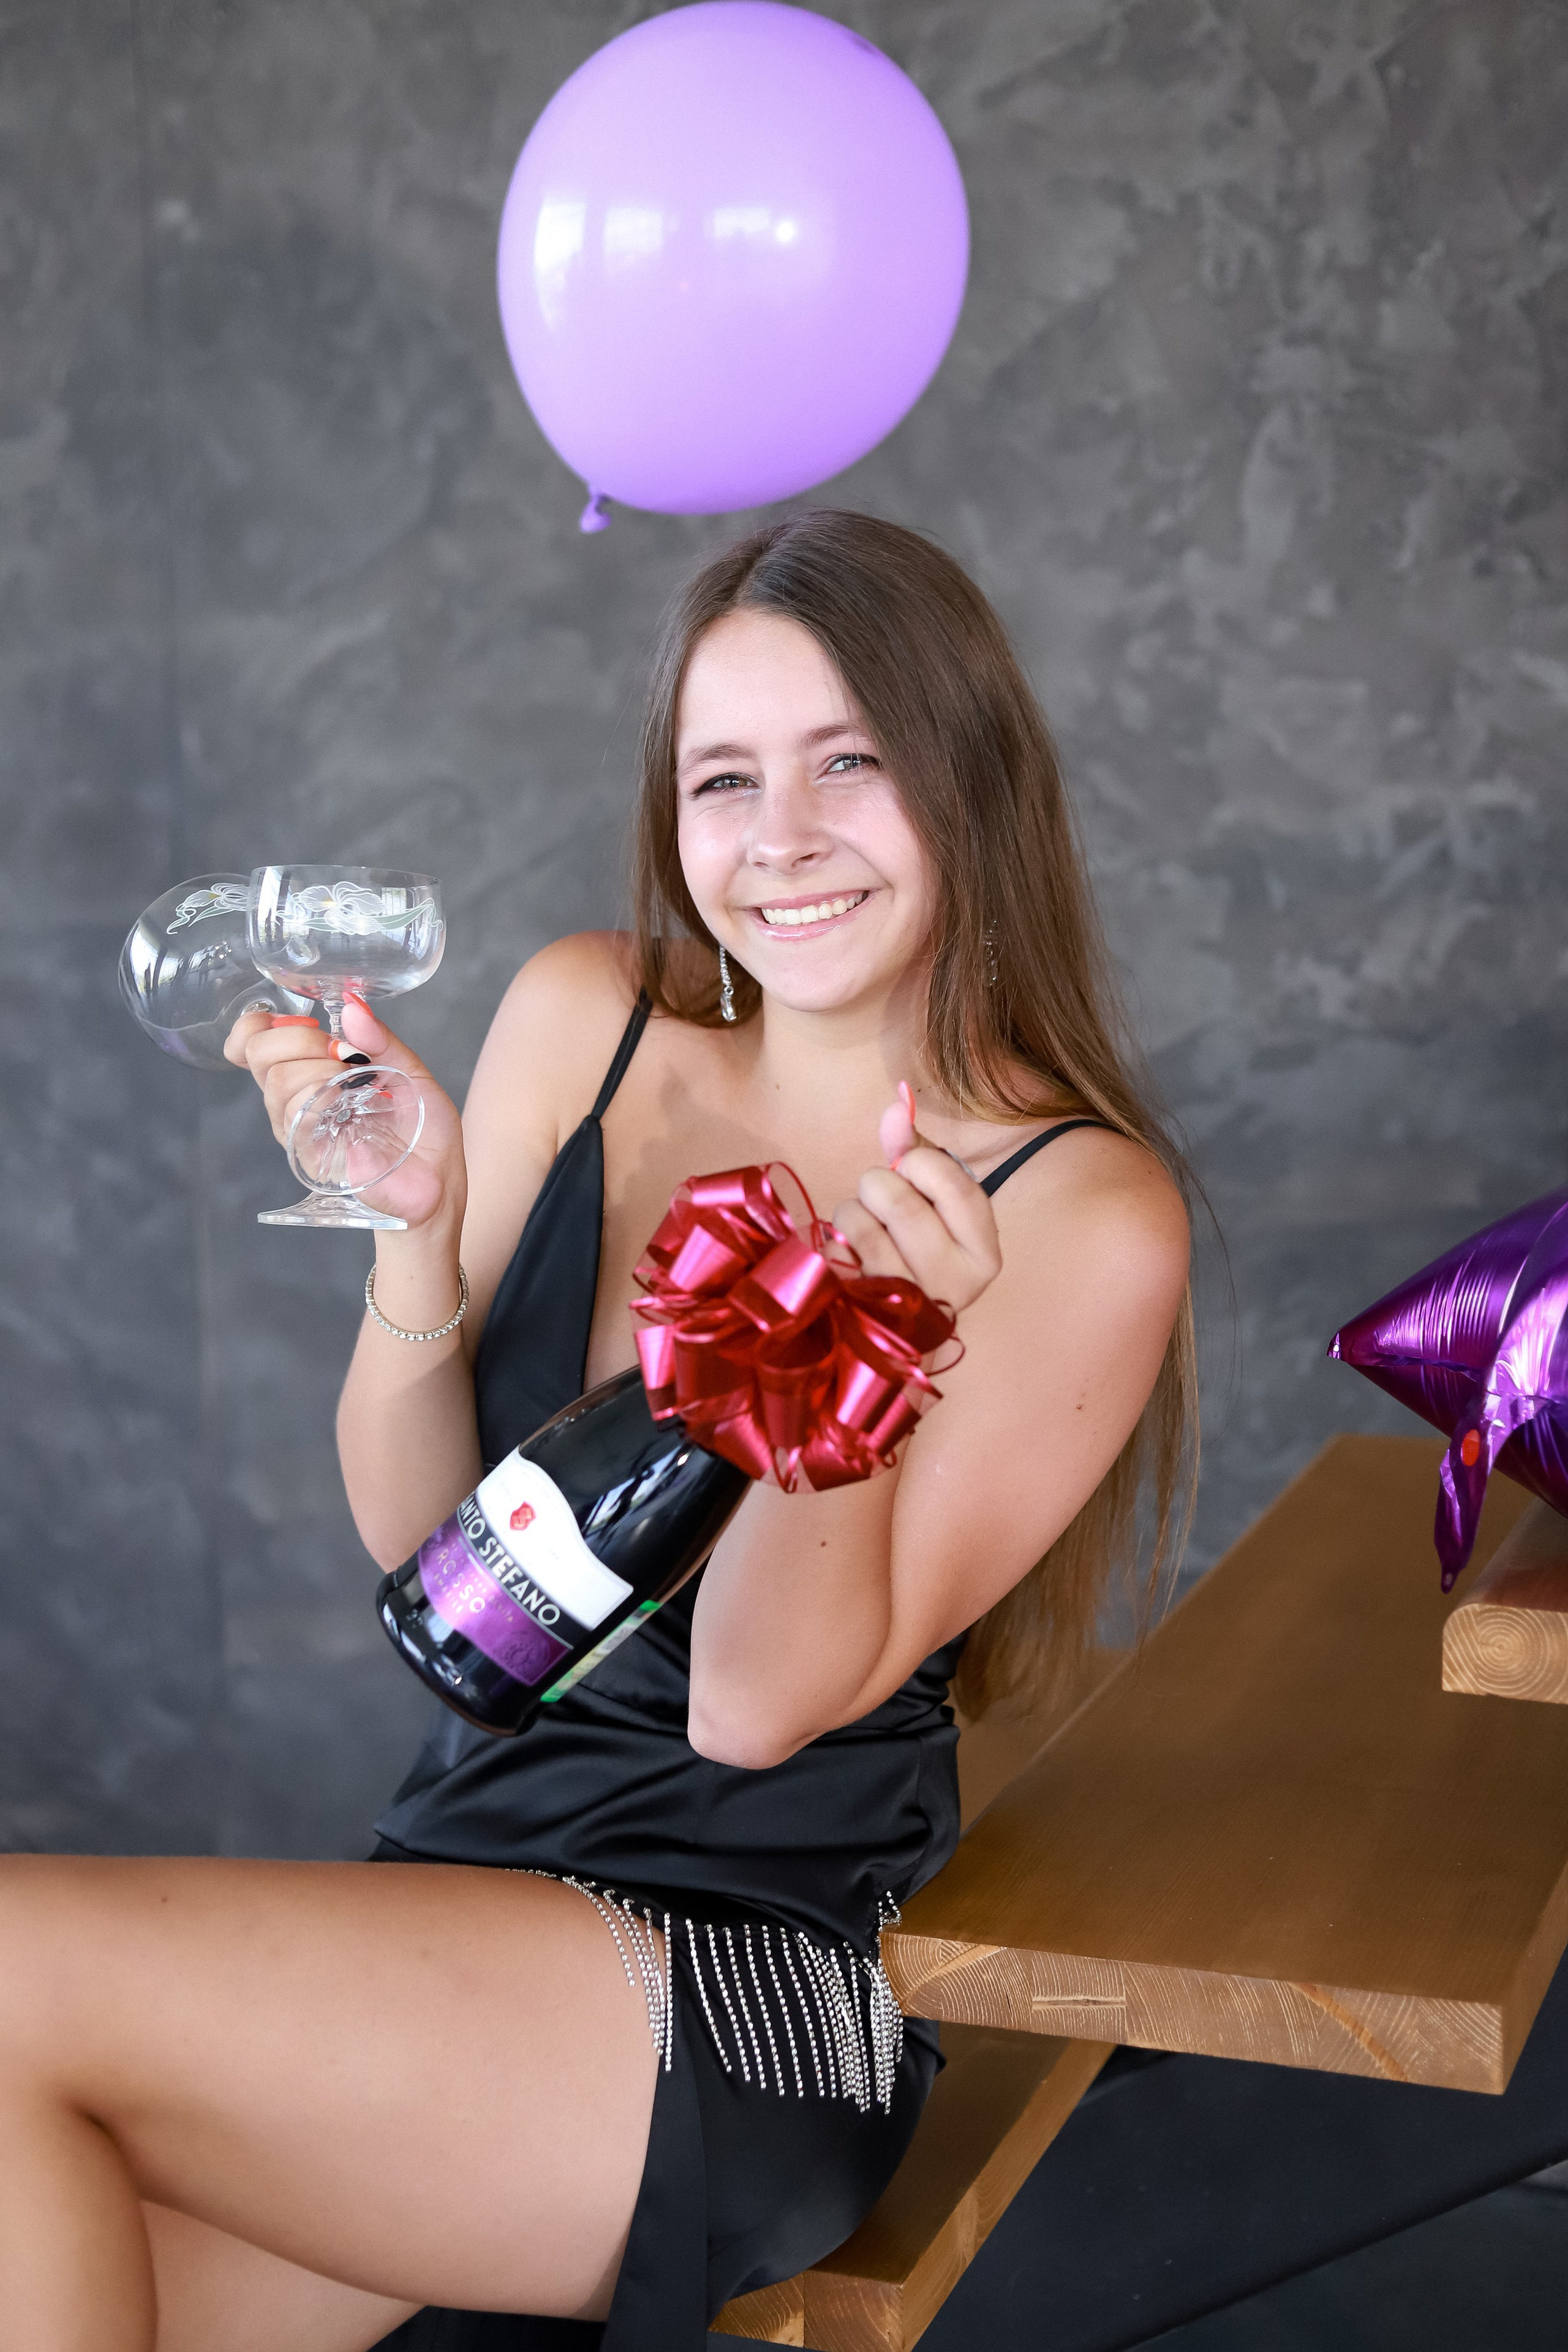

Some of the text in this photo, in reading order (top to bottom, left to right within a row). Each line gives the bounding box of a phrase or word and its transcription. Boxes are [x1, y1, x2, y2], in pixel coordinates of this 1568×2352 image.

[436, 1548, 486, 1614] ROSSO
[459, 1490, 486, 1539] ANTO
[478, 1537, 560, 1626] STEFANO
